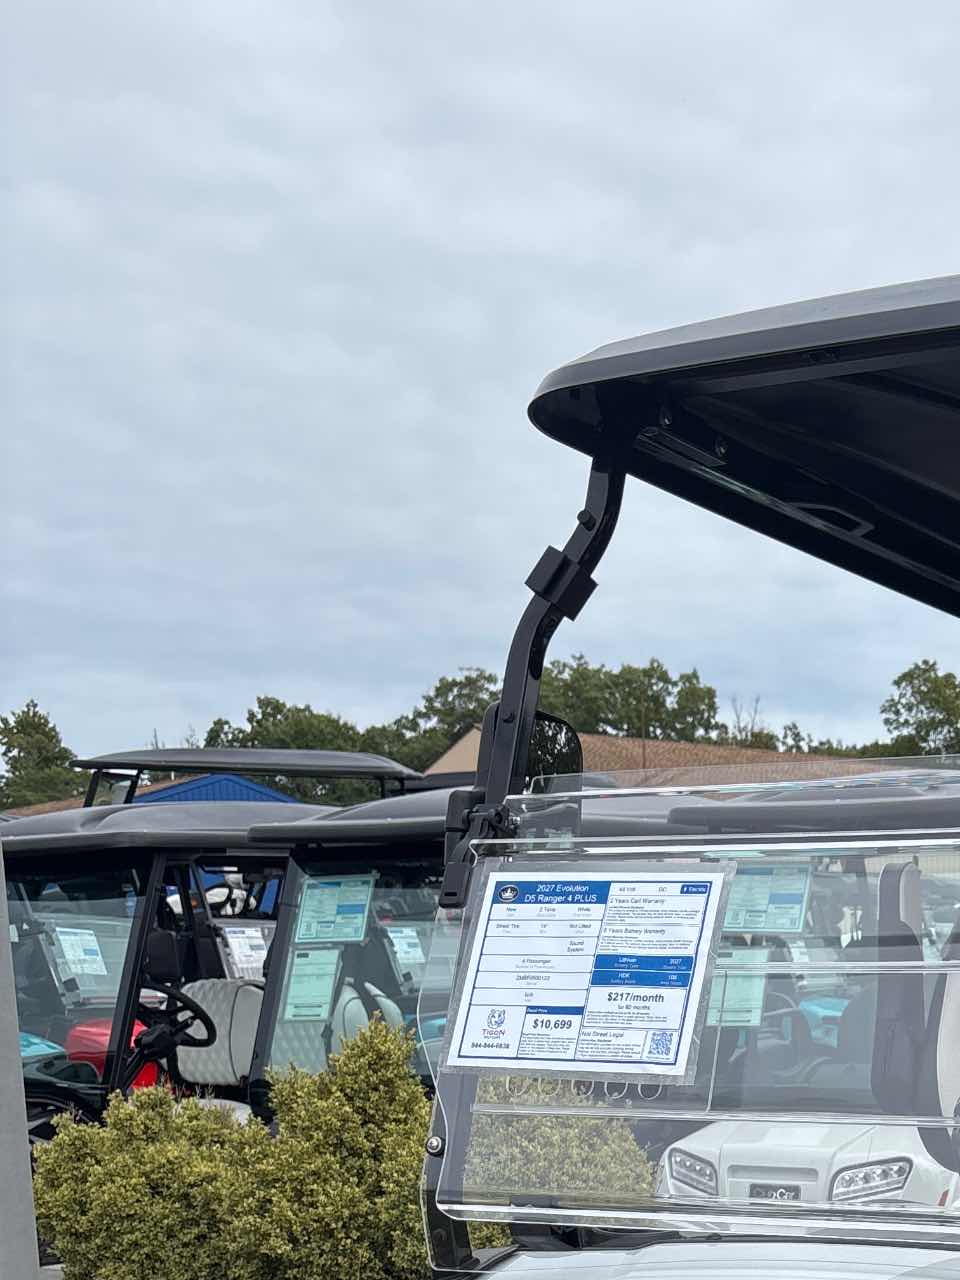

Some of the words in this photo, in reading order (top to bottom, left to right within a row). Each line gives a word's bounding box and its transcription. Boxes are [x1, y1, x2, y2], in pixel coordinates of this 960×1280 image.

[537, 884, 555, 892] 2027
[556, 884, 589, 892] Evolution
[538, 895, 567, 903] Ranger
[575, 894, 597, 902] PLUS
[608, 992, 664, 1002] $217/month
[533, 1019, 572, 1030] $10,699
